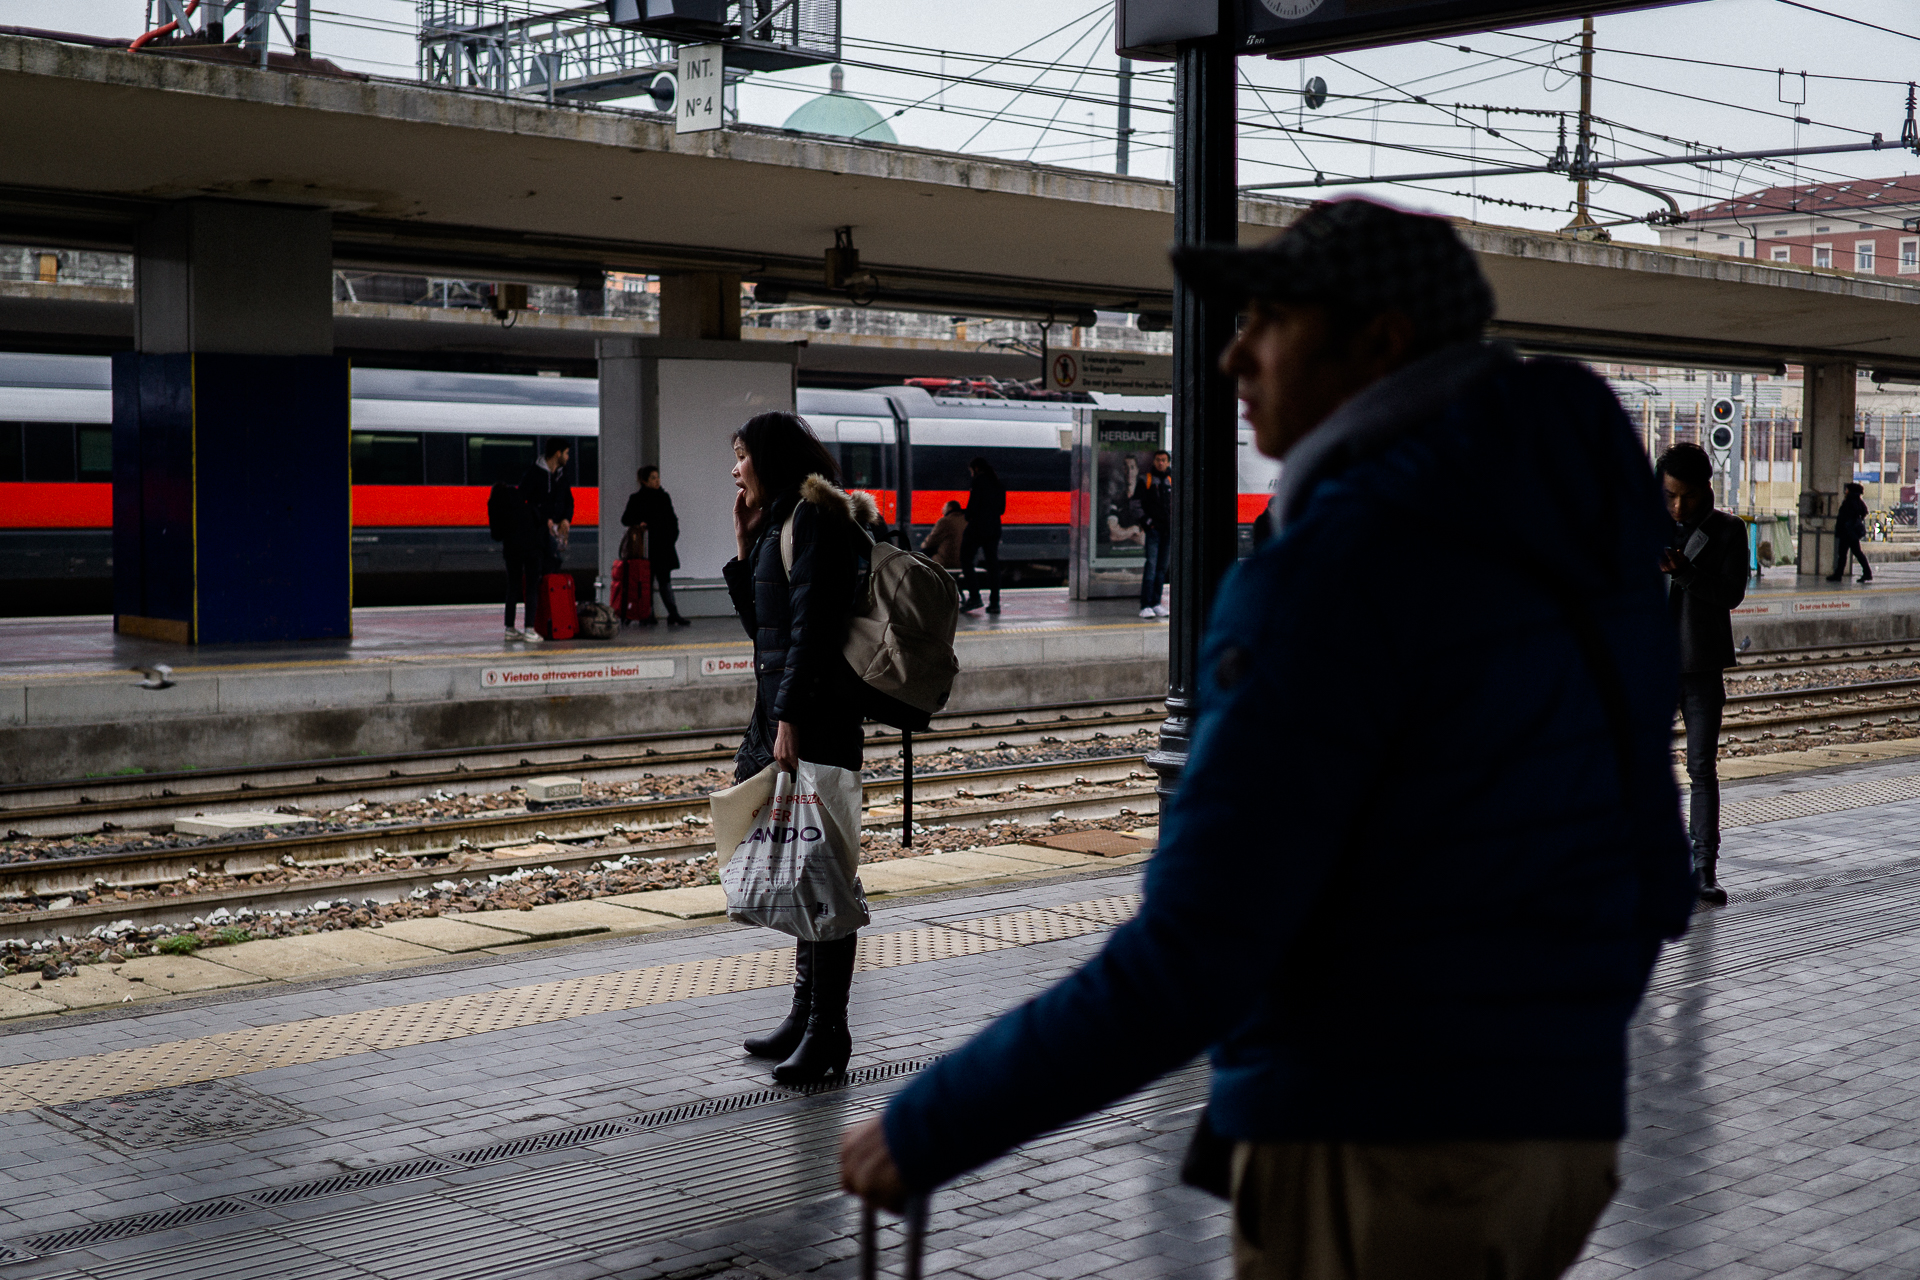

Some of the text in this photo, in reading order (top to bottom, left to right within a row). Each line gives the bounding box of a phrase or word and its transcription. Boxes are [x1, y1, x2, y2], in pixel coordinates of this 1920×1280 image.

[686, 58, 714, 80] INT.
[704, 96, 712, 115] 4
[1100, 430, 1157, 442] HERBALIFE
[502, 665, 639, 682] Vietato attraversare i binari
[718, 660, 731, 670] Do
[733, 660, 748, 669] not
